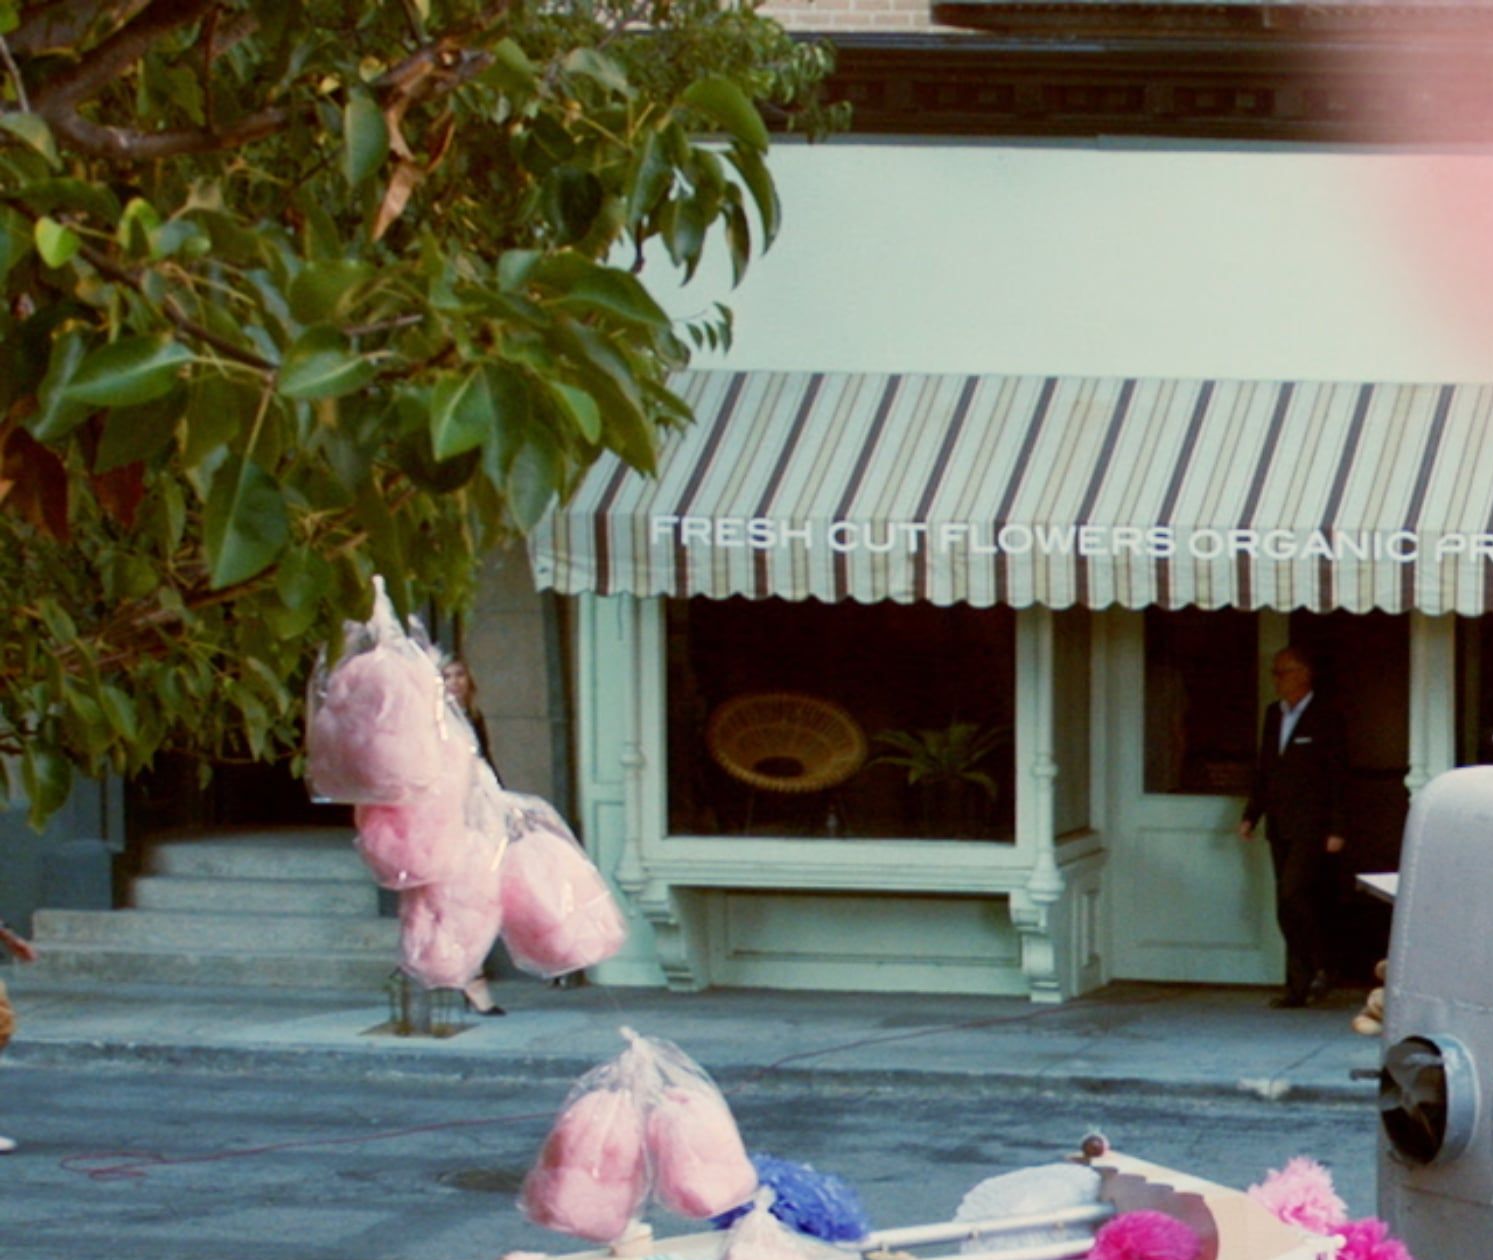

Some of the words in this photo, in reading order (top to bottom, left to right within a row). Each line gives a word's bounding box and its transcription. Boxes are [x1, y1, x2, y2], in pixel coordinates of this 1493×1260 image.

[650, 515, 813, 550] FRESH
[827, 520, 927, 553] CUT
[938, 522, 1177, 558] FLOWERS
[1188, 528, 1419, 562] ORGANIC
